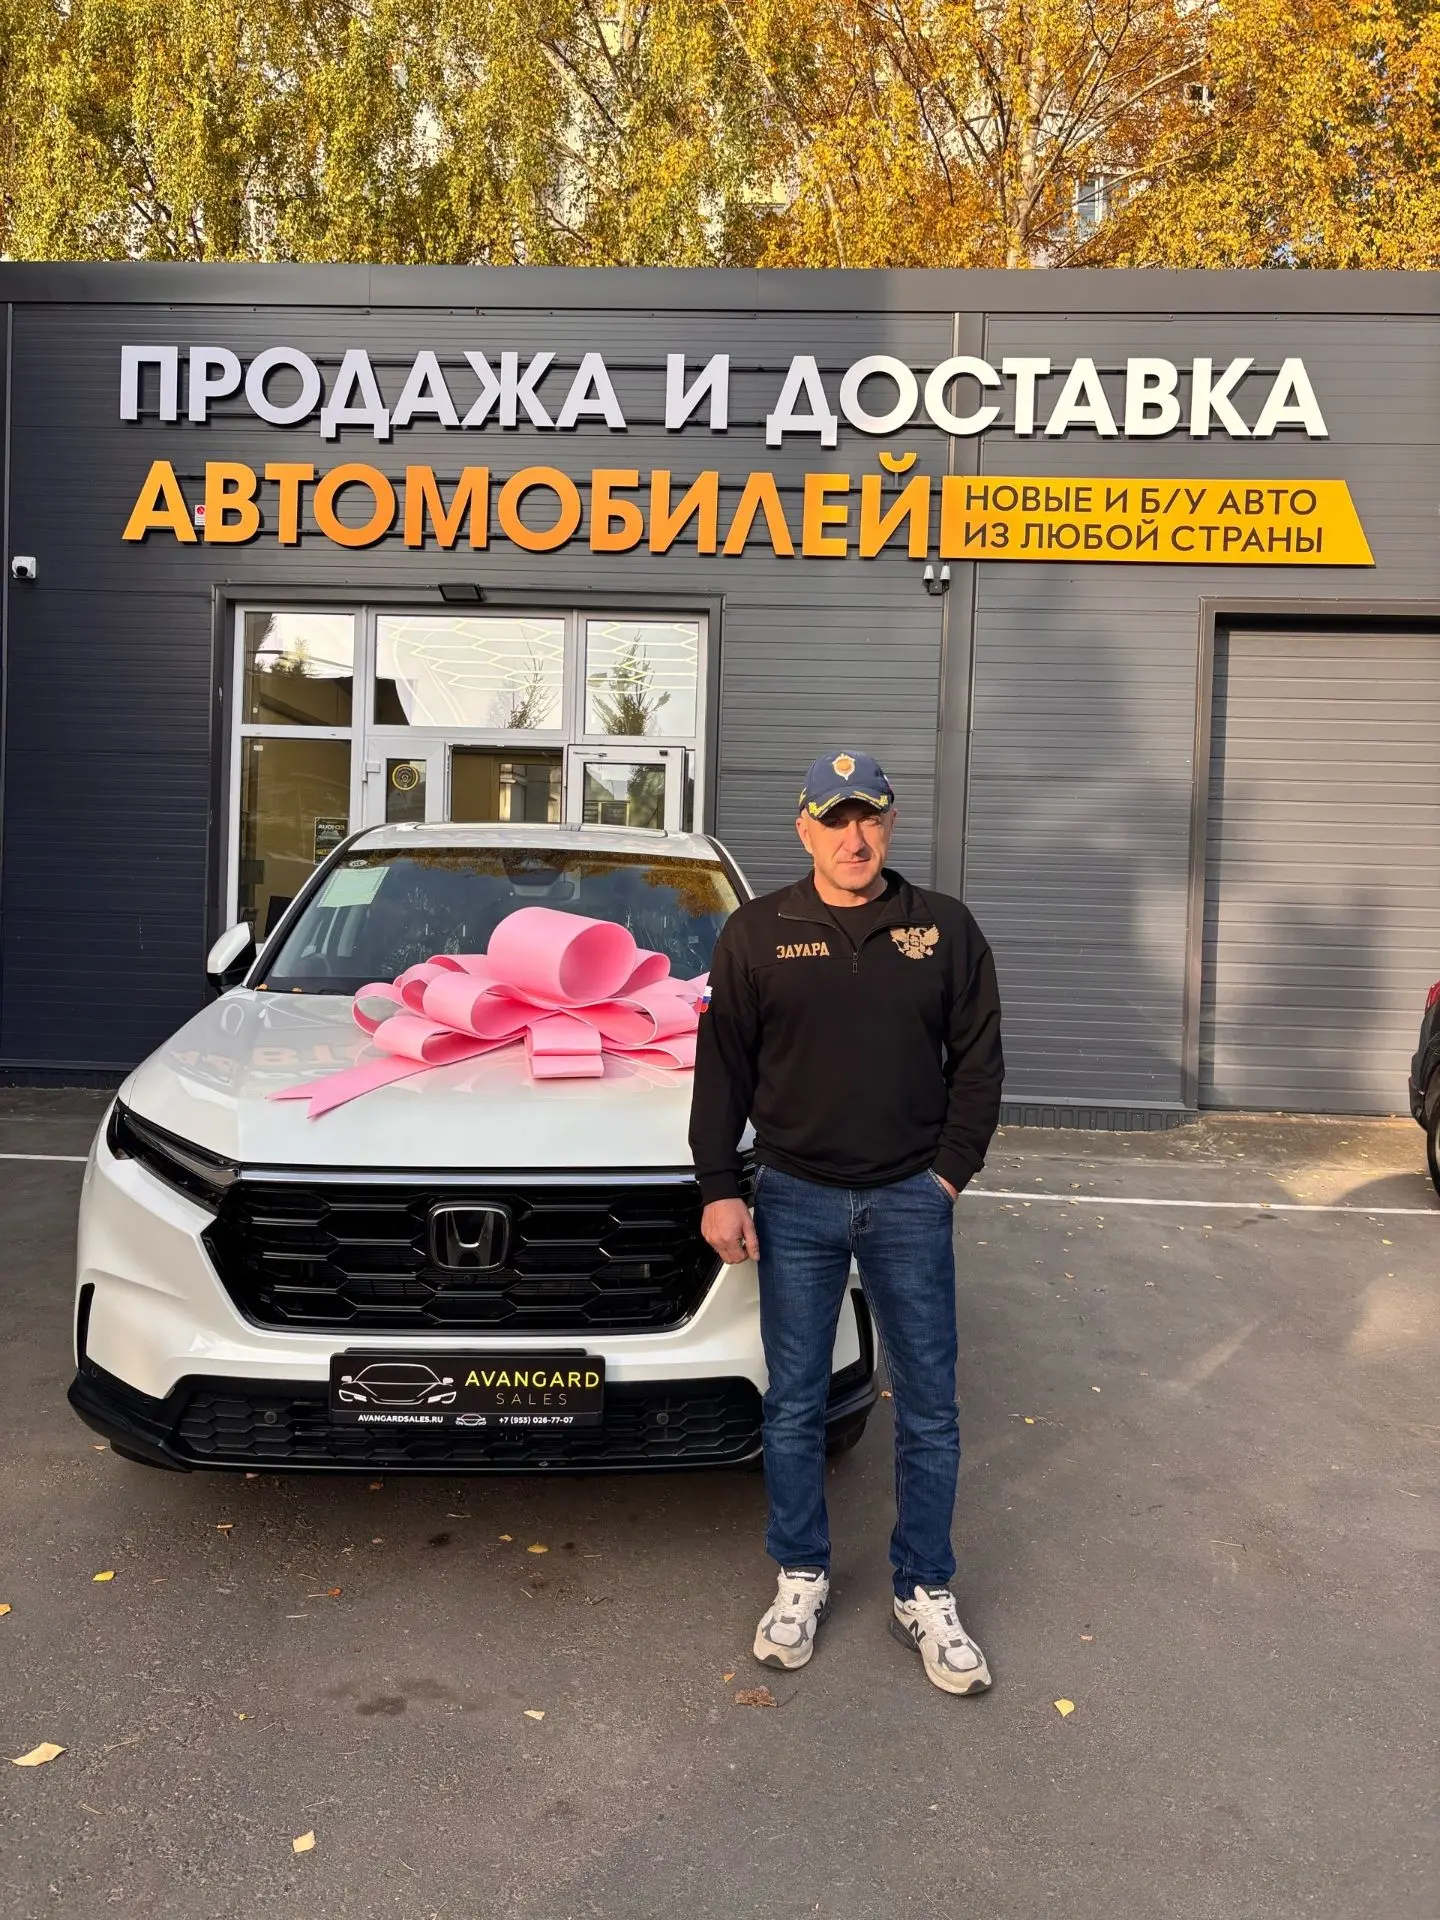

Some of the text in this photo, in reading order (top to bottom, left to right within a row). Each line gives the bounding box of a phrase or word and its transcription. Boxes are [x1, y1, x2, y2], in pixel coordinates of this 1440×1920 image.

[119, 345, 1329, 447] ПРОДАЖА И ДОСТАВКА
[122, 452, 931, 558] АВТОМОБИЛЕЙ
[965, 485, 1317, 516] НОВЫЕ И Б/У АВТО
[964, 518, 1323, 553] ИЗ ЛЮБОЙ СТРАНЫ
[465, 1370, 600, 1388] AVANGARD
[497, 1392, 568, 1406] SALES
[357, 1414, 574, 1425] AVANGARDSALES.RU +7 (953) 026-77-07
